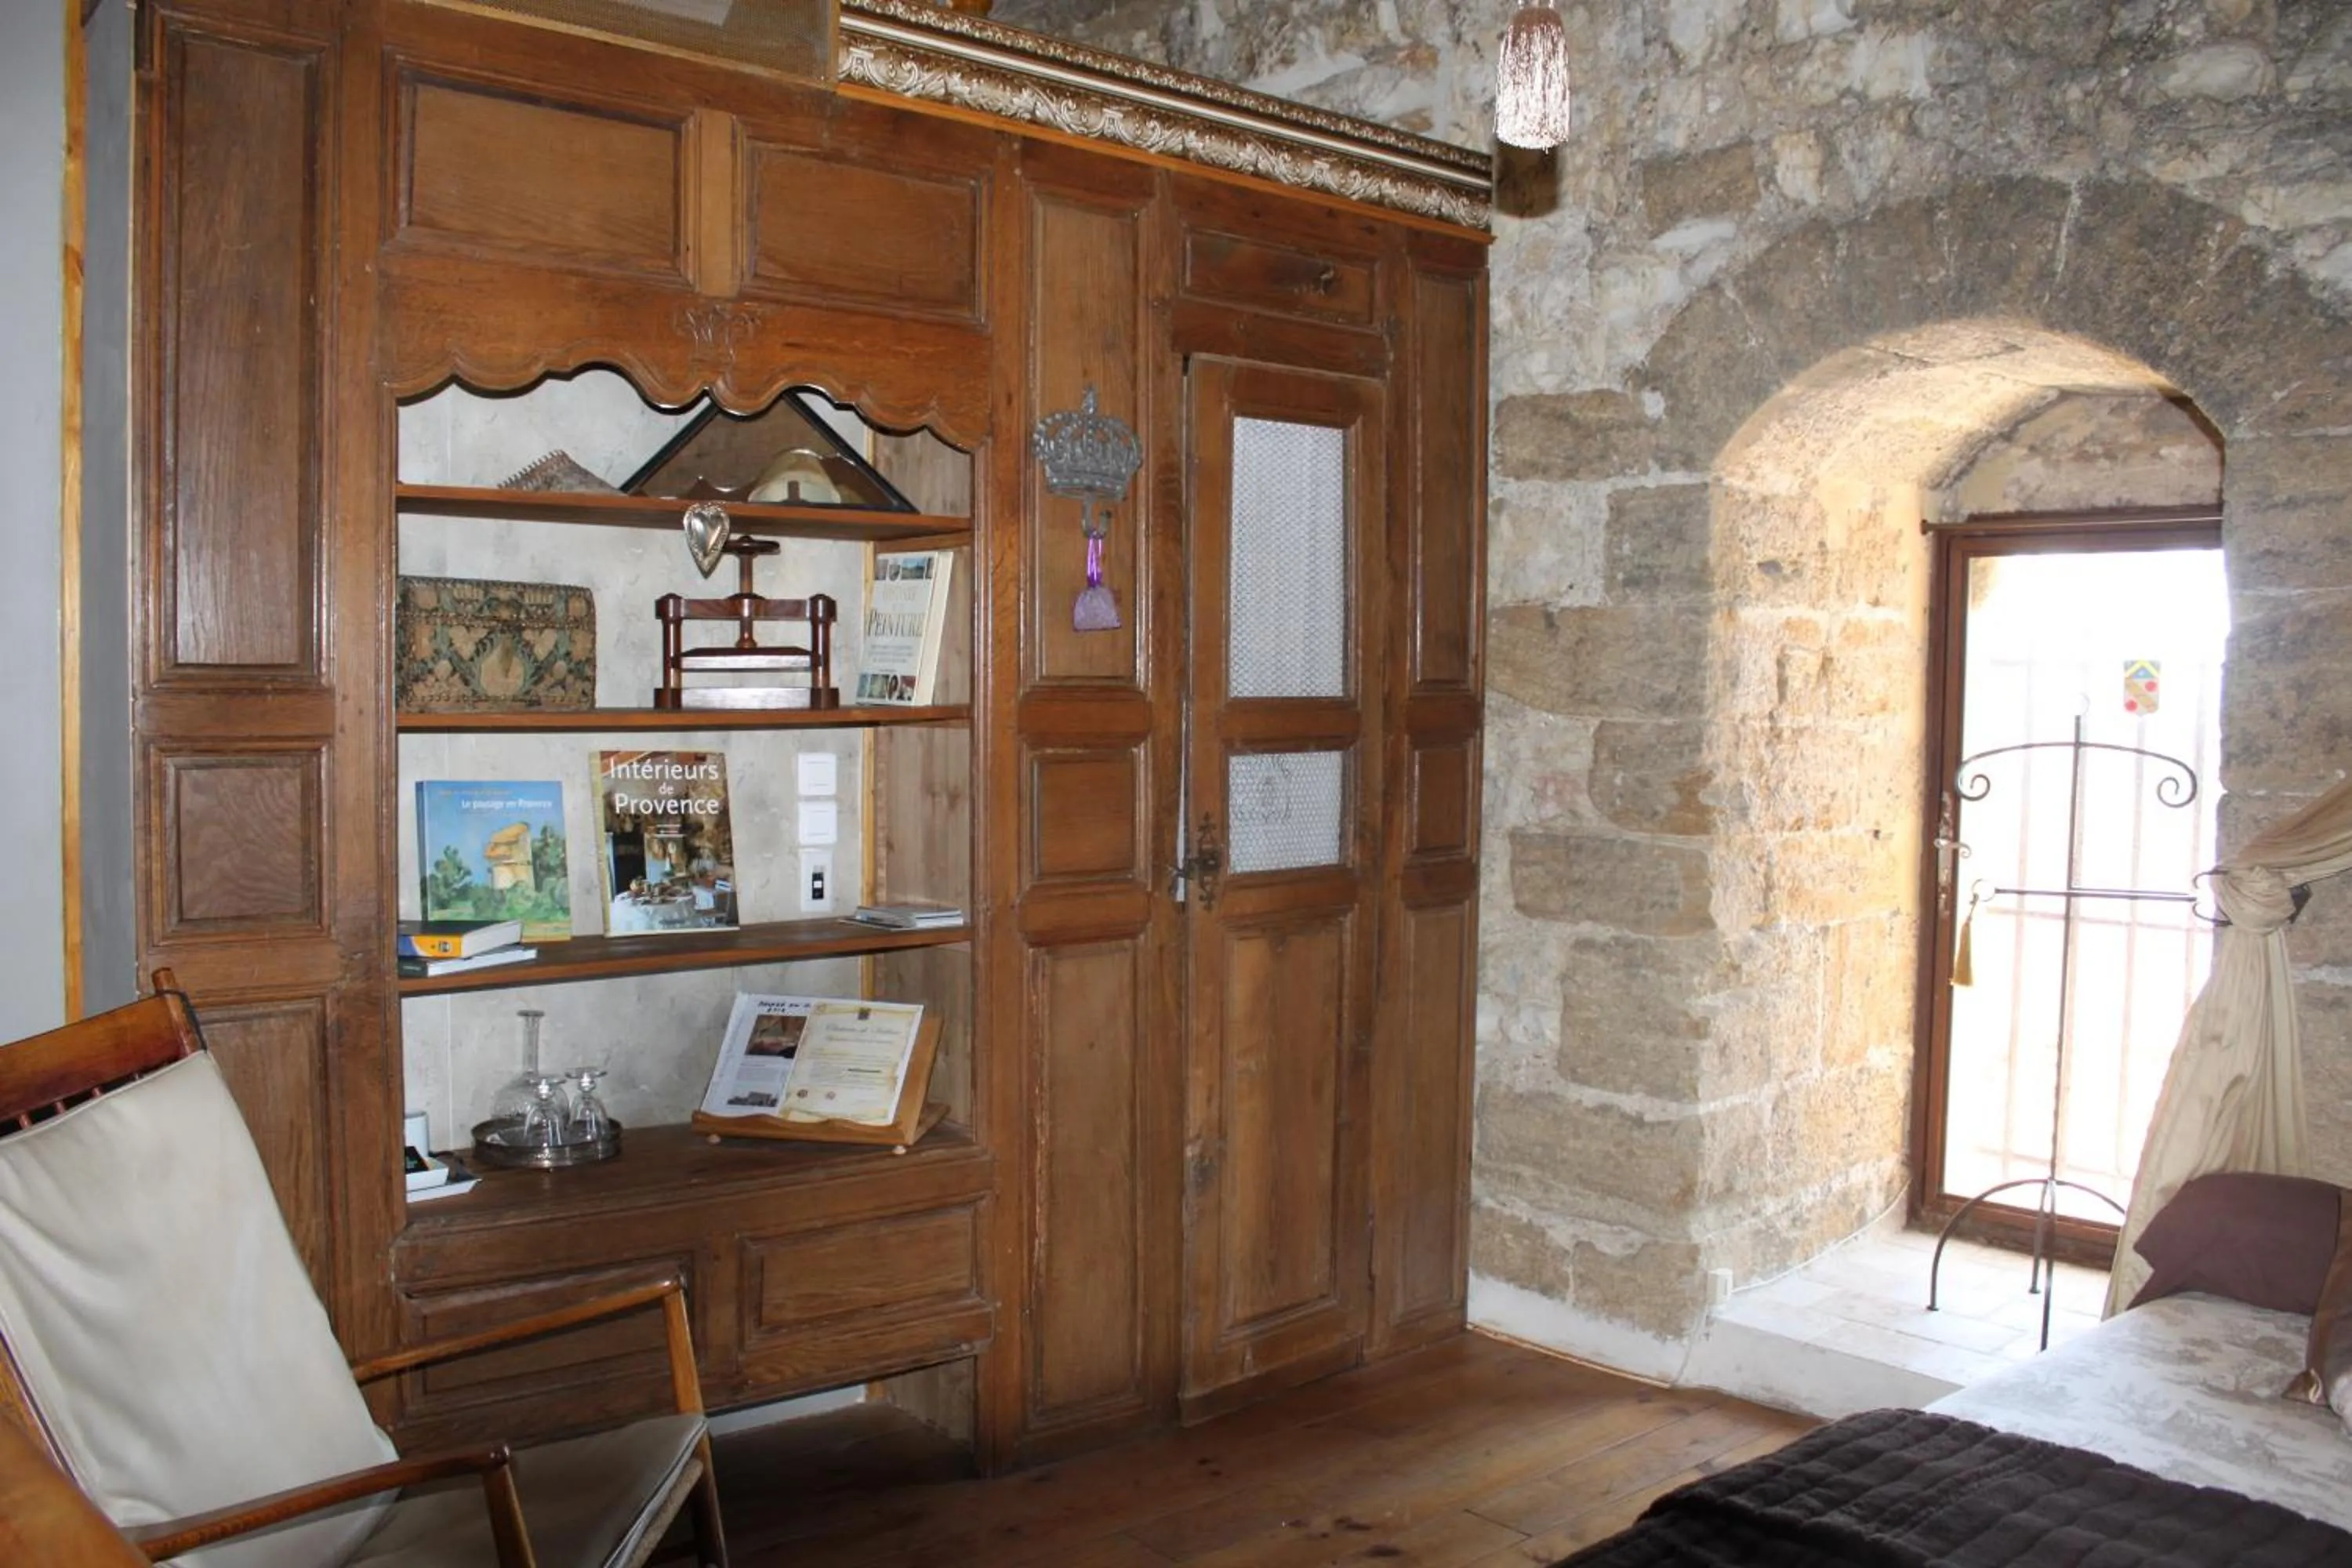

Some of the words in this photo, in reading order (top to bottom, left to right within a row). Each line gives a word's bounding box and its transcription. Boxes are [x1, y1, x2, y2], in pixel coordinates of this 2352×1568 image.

[610, 757, 720, 780] Intérieurs
[658, 782, 674, 794] de
[614, 793, 720, 815] Provence
